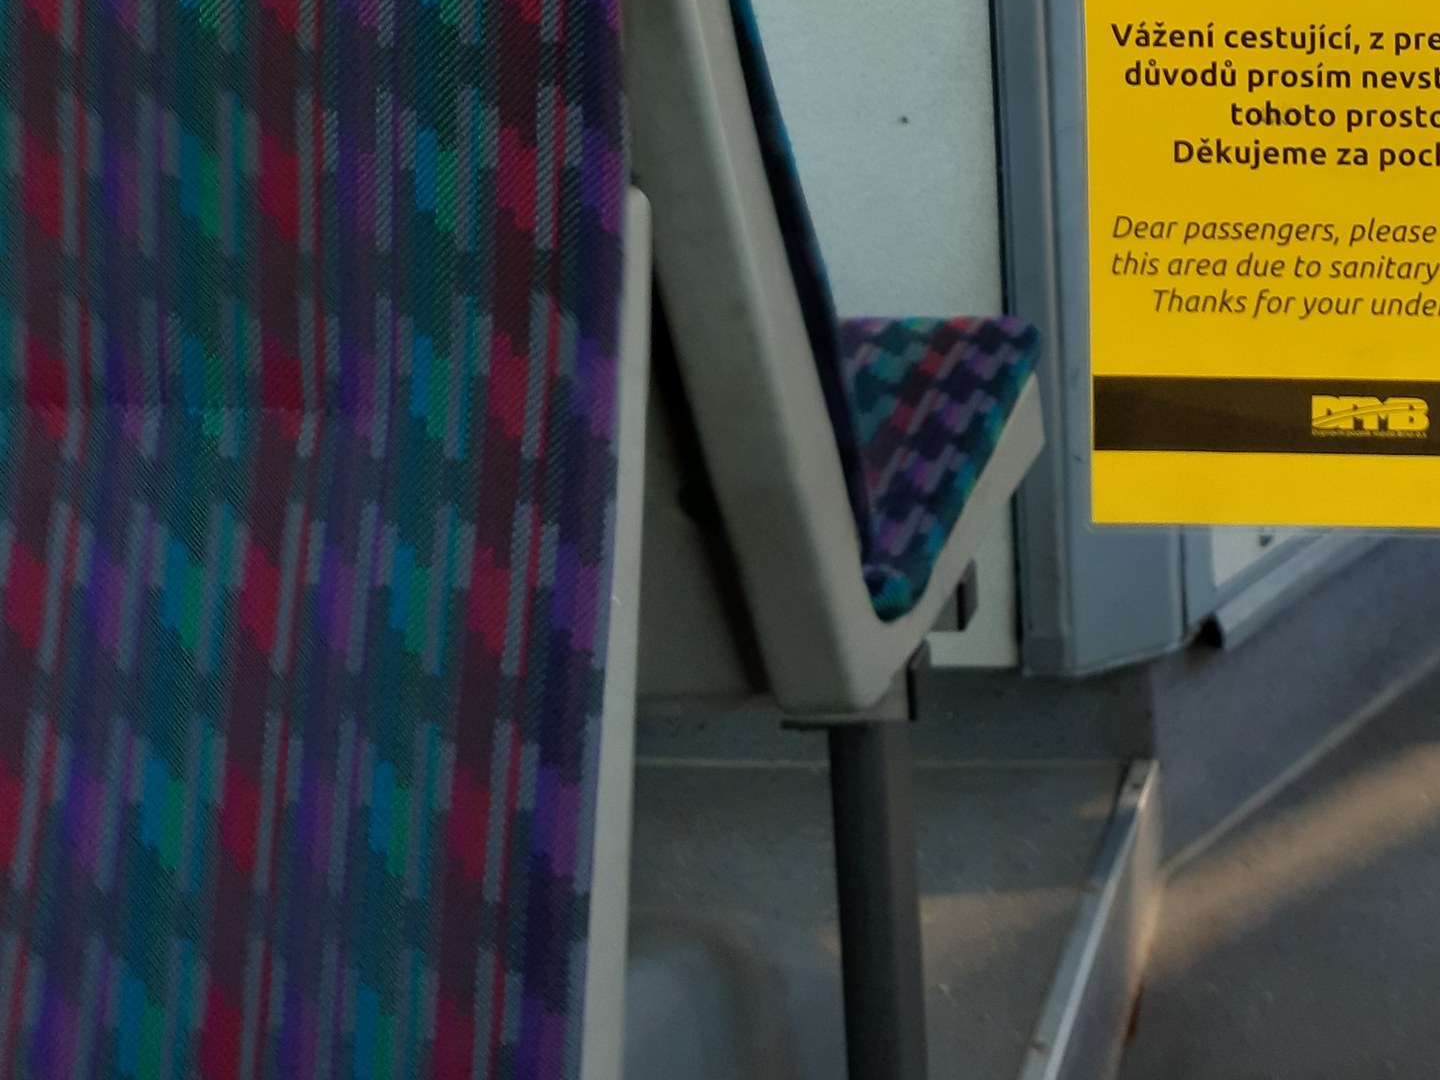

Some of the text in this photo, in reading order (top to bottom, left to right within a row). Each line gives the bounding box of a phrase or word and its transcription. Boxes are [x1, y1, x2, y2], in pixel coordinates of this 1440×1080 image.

[1110, 21, 1214, 48] Vážení
[1224, 23, 1360, 55] cestující,
[1369, 32, 1385, 50] z
[1124, 58, 1237, 87] důvodů
[1247, 62, 1351, 93] prosím
[1231, 100, 1336, 127] tohoto
[1173, 138, 1327, 170] Děkujeme
[1336, 147, 1369, 166] za
[1112, 215, 1178, 239] Dear
[1183, 221, 1339, 246] passengers,
[1348, 217, 1437, 247] please
[1111, 251, 1159, 275] this
[1167, 258, 1228, 276] area
[1236, 253, 1286, 277] due
[1294, 256, 1322, 278] to
[1329, 255, 1440, 285] sanitary
[1154, 289, 1247, 313] Thanks
[1253, 289, 1295, 317] for
[1299, 297, 1363, 319] your
[1311, 394, 1430, 431] DPMB
